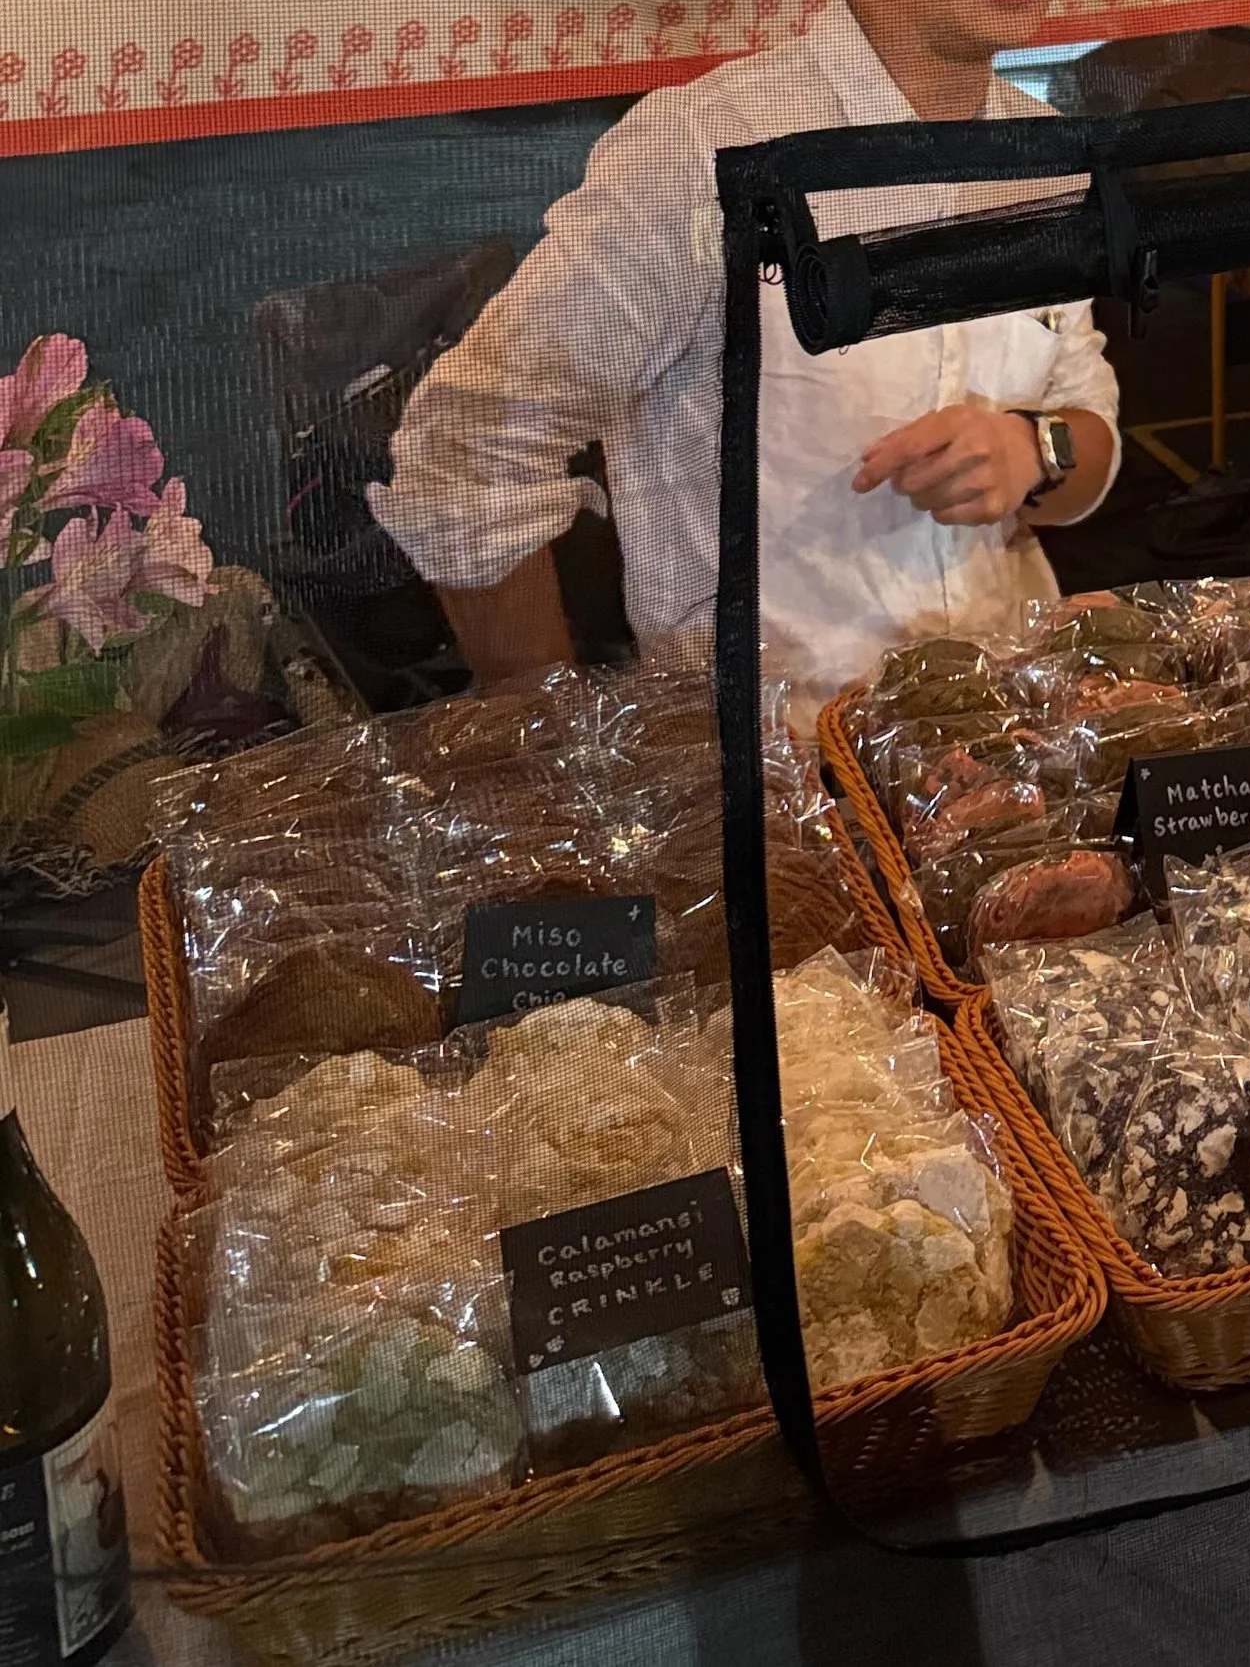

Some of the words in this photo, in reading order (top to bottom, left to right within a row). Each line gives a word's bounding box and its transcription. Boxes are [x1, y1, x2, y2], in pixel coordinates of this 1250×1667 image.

[512, 921, 582, 948] Miso
[481, 952, 628, 979] Chocolate
[538, 1200, 703, 1265] Calamansi
[550, 1238, 694, 1288] Raspberry
[549, 1262, 714, 1326] CRINKLE
